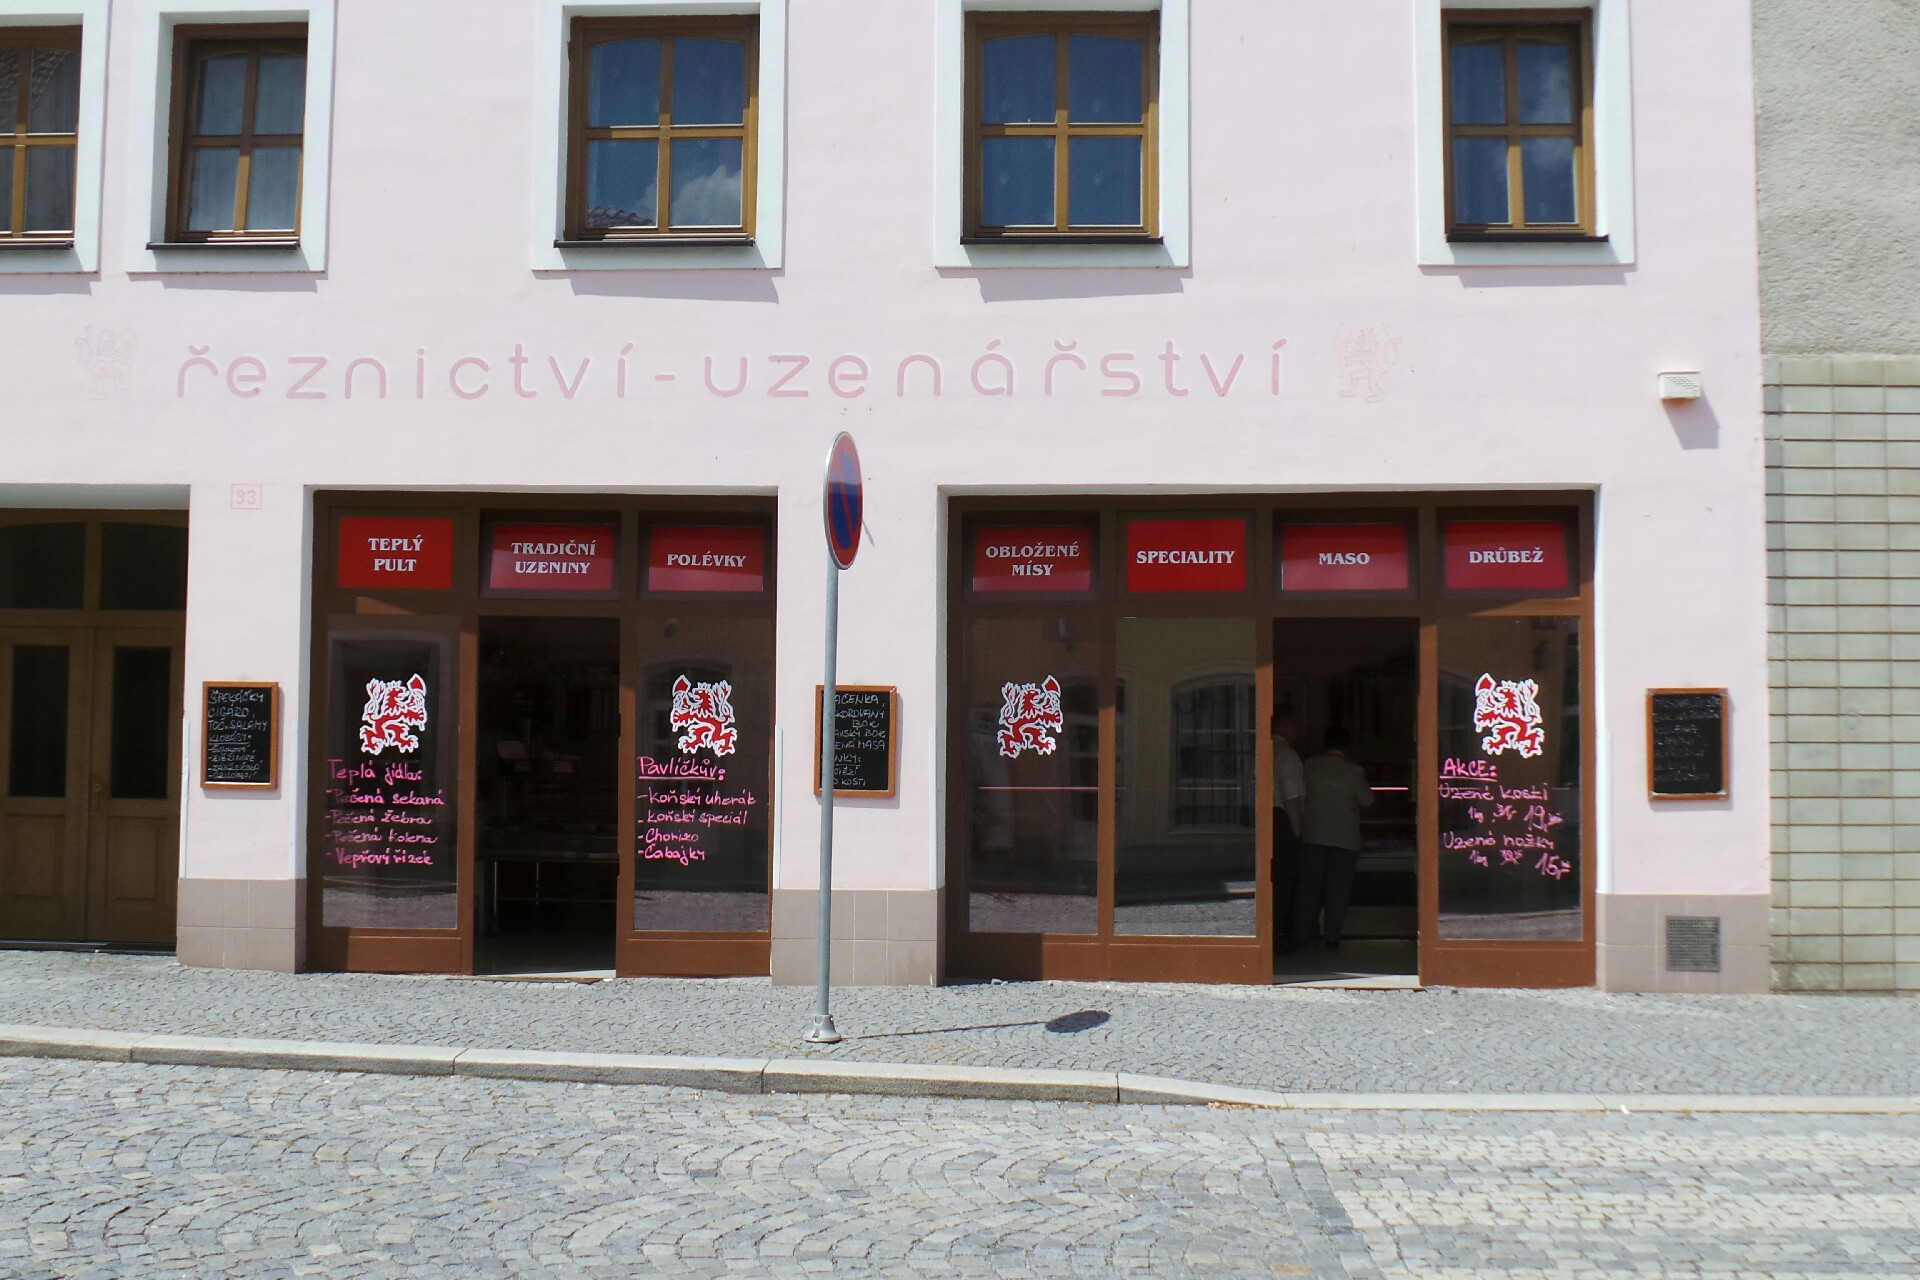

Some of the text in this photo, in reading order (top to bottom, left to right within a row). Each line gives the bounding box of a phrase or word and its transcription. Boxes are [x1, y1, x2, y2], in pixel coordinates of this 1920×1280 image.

[177, 339, 1288, 400] řeznictví-uzenářství
[236, 489, 256, 505] 93
[368, 534, 424, 551] TEPLÝ
[510, 540, 597, 556] TRADIČNÍ
[985, 541, 1080, 558] OBLOŽENÉ
[666, 550, 747, 568] POLÉVKY
[1136, 550, 1236, 564] SPECIALITY
[1318, 552, 1371, 565] MASO
[1469, 546, 1544, 563] DRŮBEŽ
[373, 558, 417, 572] PULT
[514, 561, 591, 574] UZENINY
[1011, 560, 1054, 576] MÍSY
[834, 738, 855, 750] ENÁ
[327, 759, 376, 786] Teplá
[392, 789, 445, 805] sekaná
